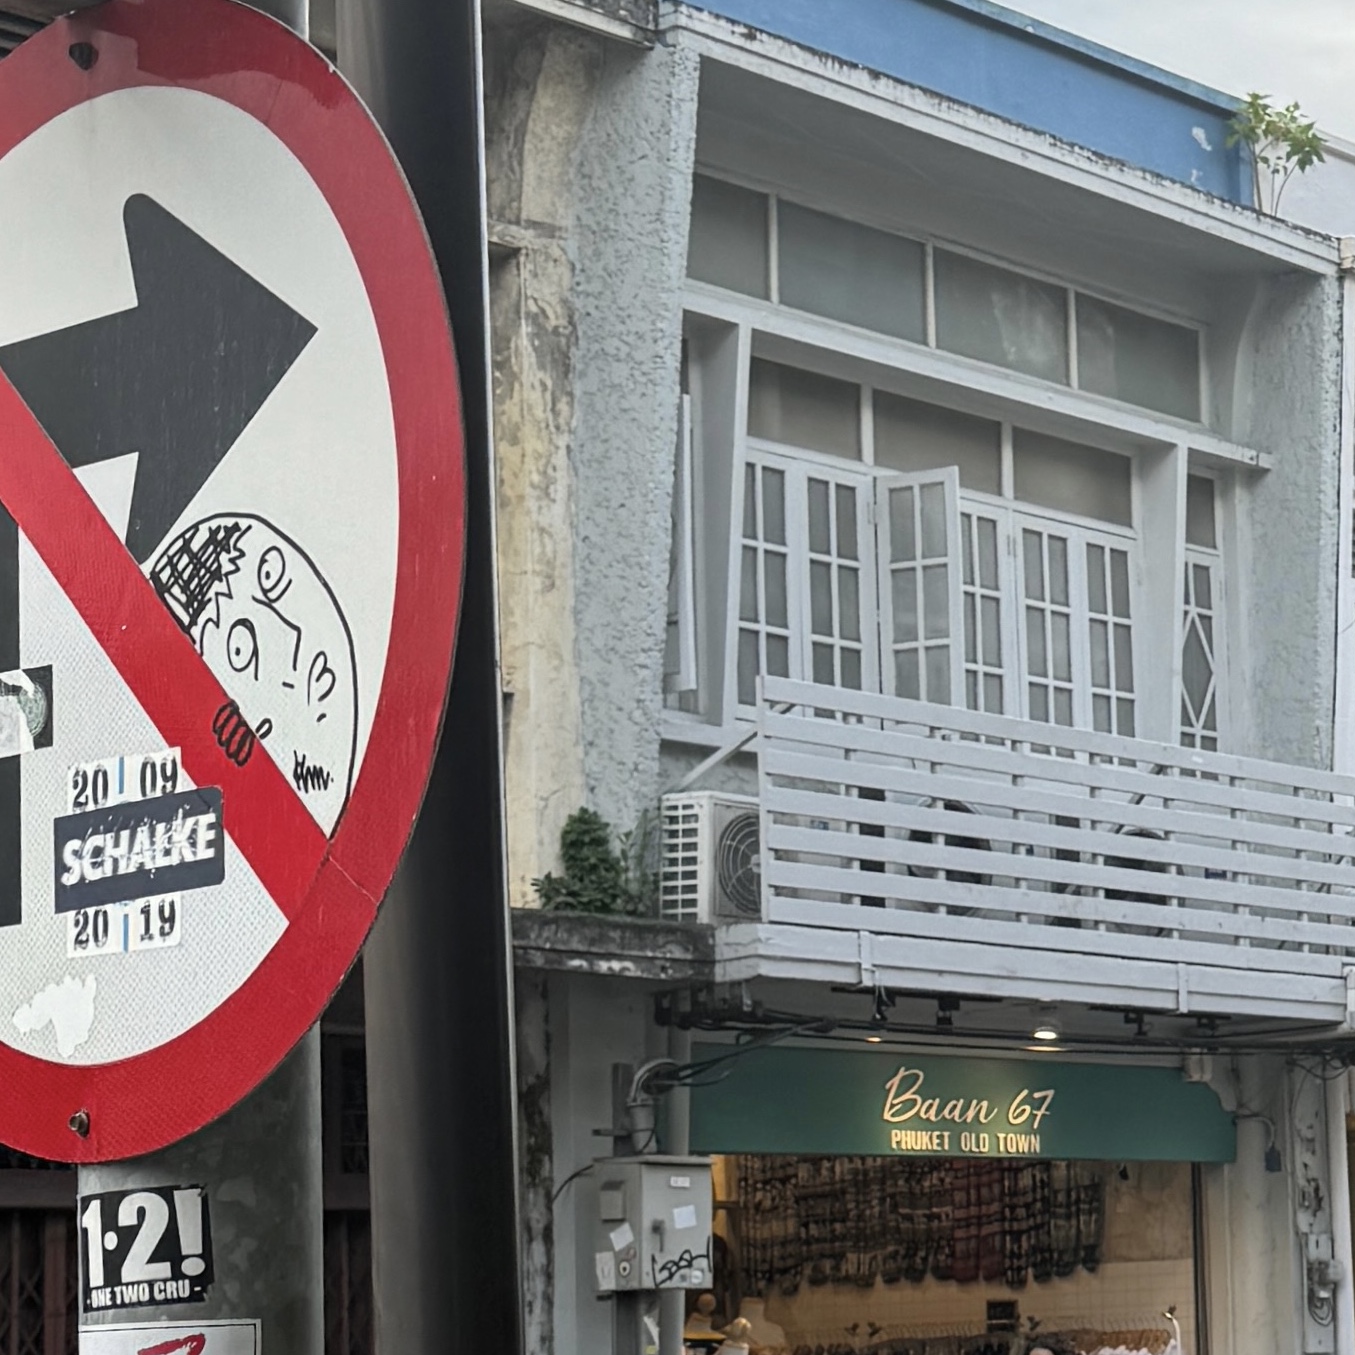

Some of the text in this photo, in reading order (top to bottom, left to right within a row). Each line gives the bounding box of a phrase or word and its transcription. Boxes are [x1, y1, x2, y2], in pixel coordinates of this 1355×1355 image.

[72, 765, 109, 813] 20
[61, 812, 217, 886] SCHALKE
[73, 900, 176, 950] 20 19
[883, 1066, 1055, 1129] Baan 67
[891, 1129, 1041, 1154] PHUKET OLD TOWN
[114, 1283, 150, 1305] TWO
[153, 1279, 190, 1301] CRU
